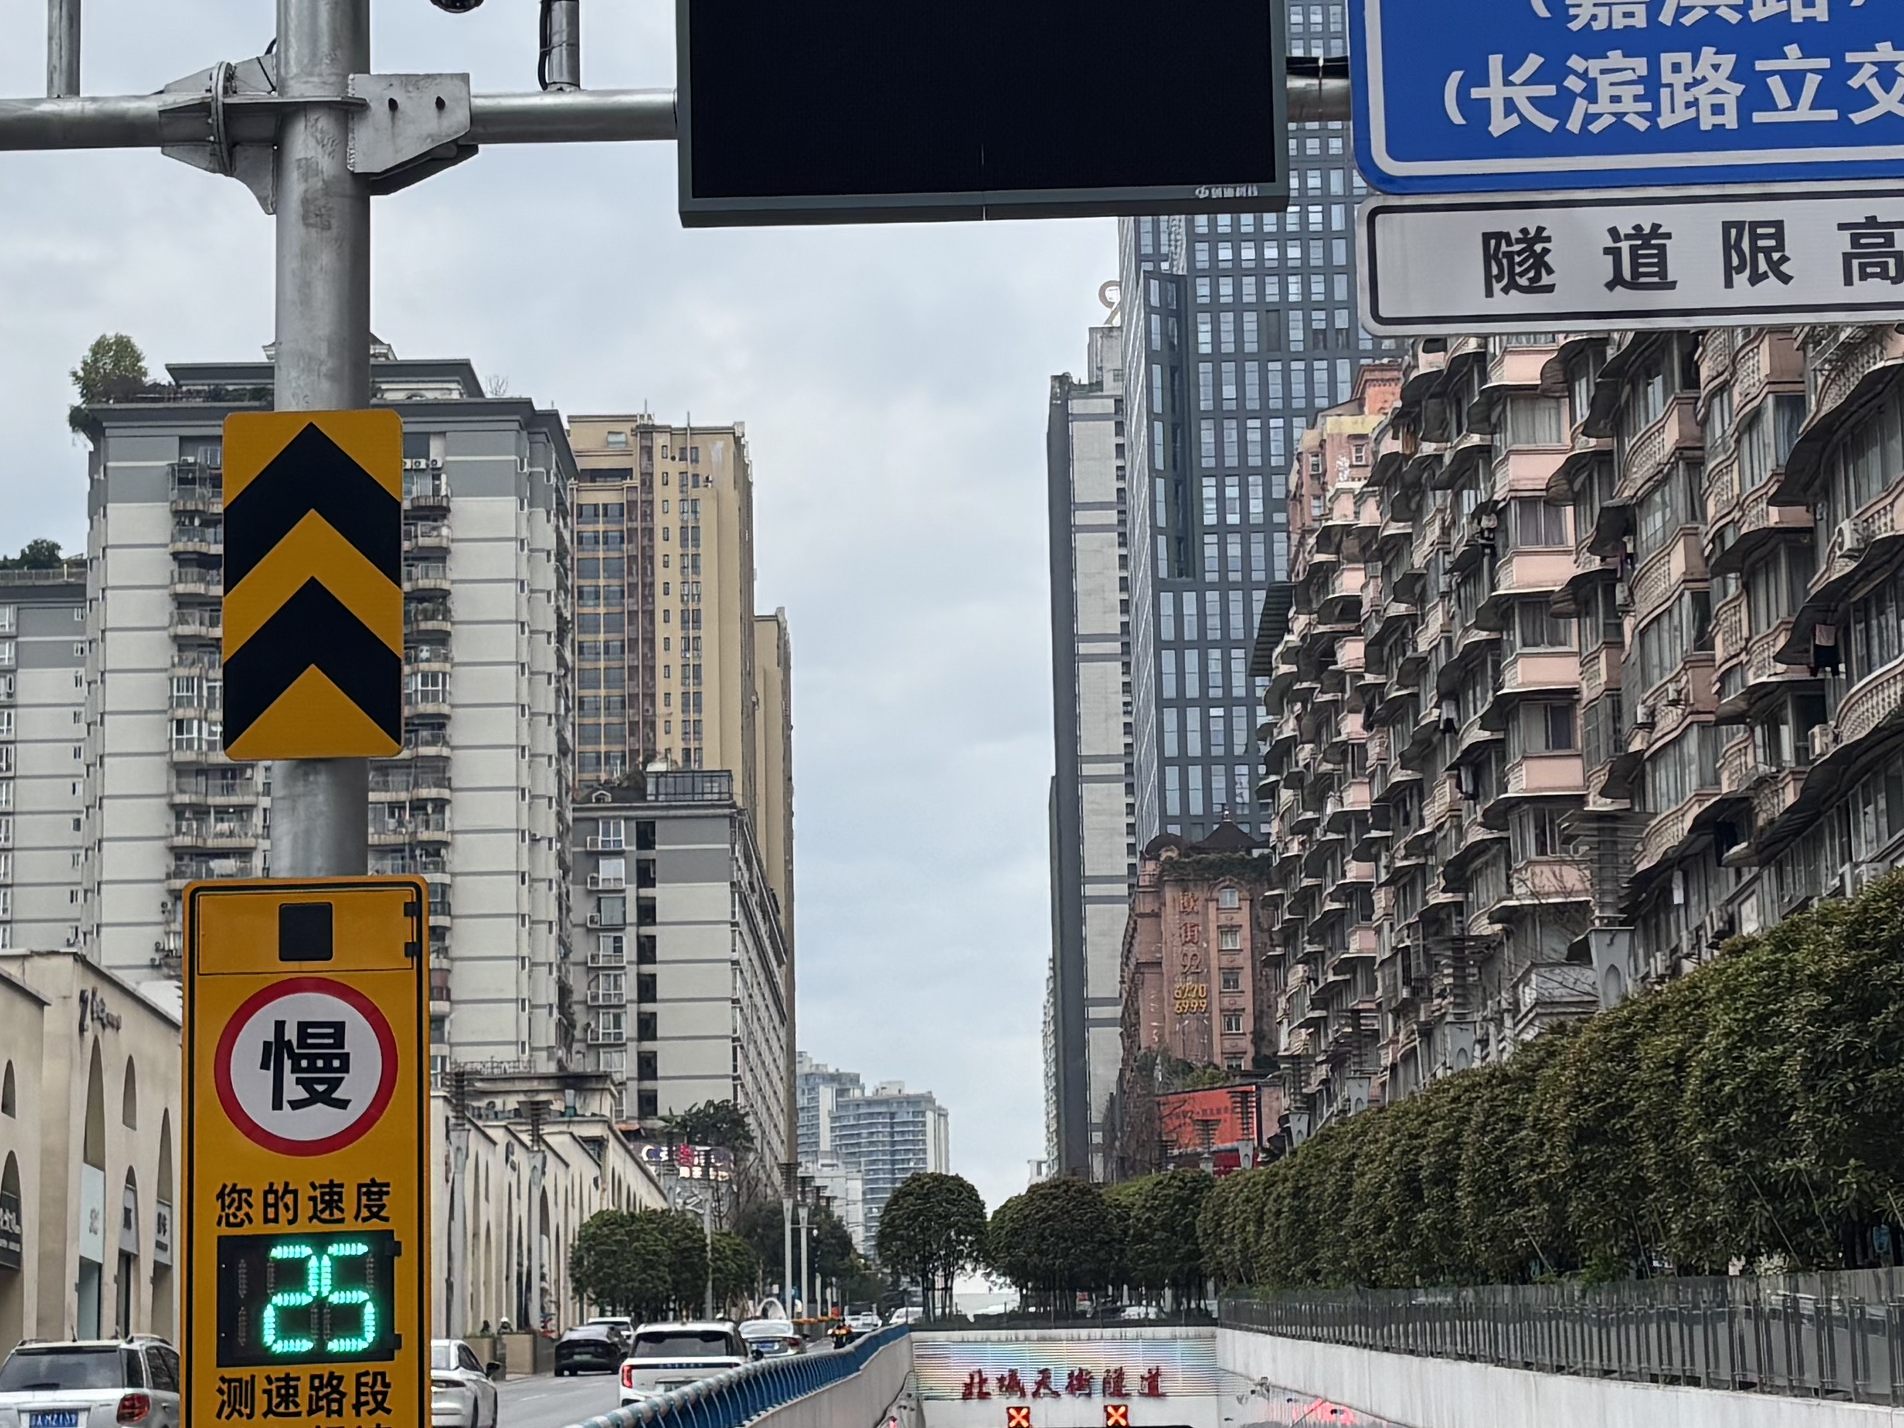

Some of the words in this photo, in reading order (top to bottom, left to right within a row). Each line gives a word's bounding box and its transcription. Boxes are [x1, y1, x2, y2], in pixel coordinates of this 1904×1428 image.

[259, 1019, 353, 1112] 慢
[215, 1176, 392, 1227] 您的速度
[262, 1242, 376, 1354] 25
[214, 1368, 394, 1422] 测速路段
